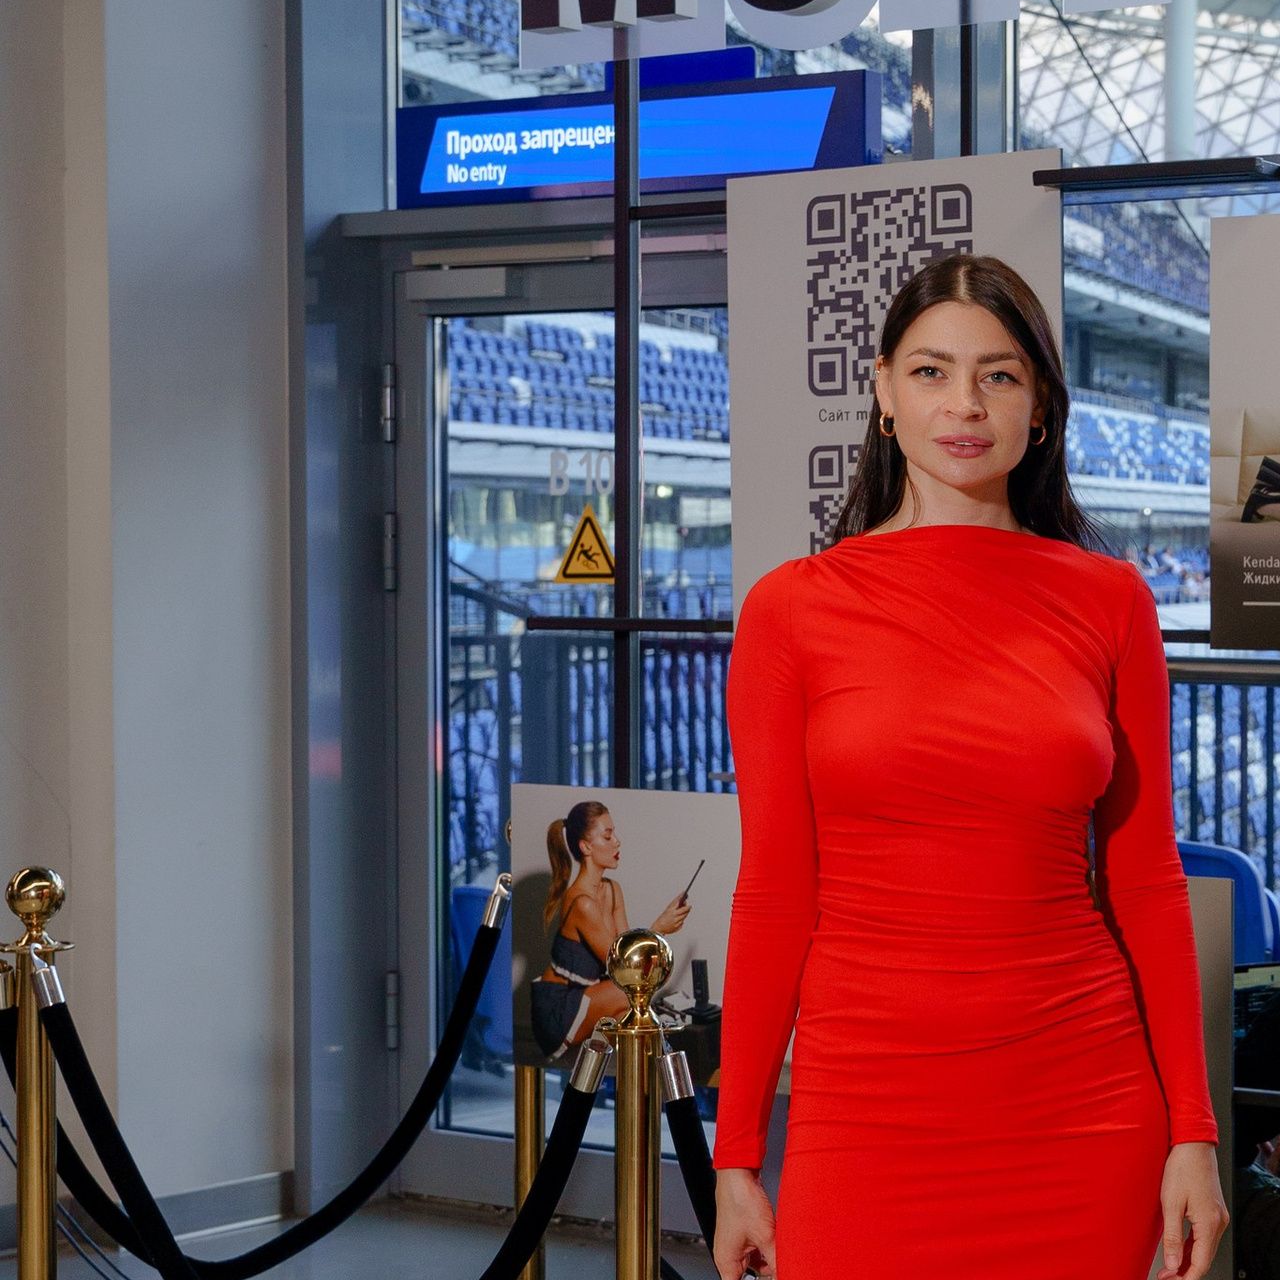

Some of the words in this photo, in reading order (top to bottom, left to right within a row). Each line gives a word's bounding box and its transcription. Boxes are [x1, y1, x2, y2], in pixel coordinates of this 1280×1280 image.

[447, 130, 518, 160] Проход
[520, 125, 615, 154] запрещен
[446, 164, 468, 184] No
[470, 162, 507, 186] entry
[818, 408, 851, 422] Сайт
[579, 450, 615, 496] 10
